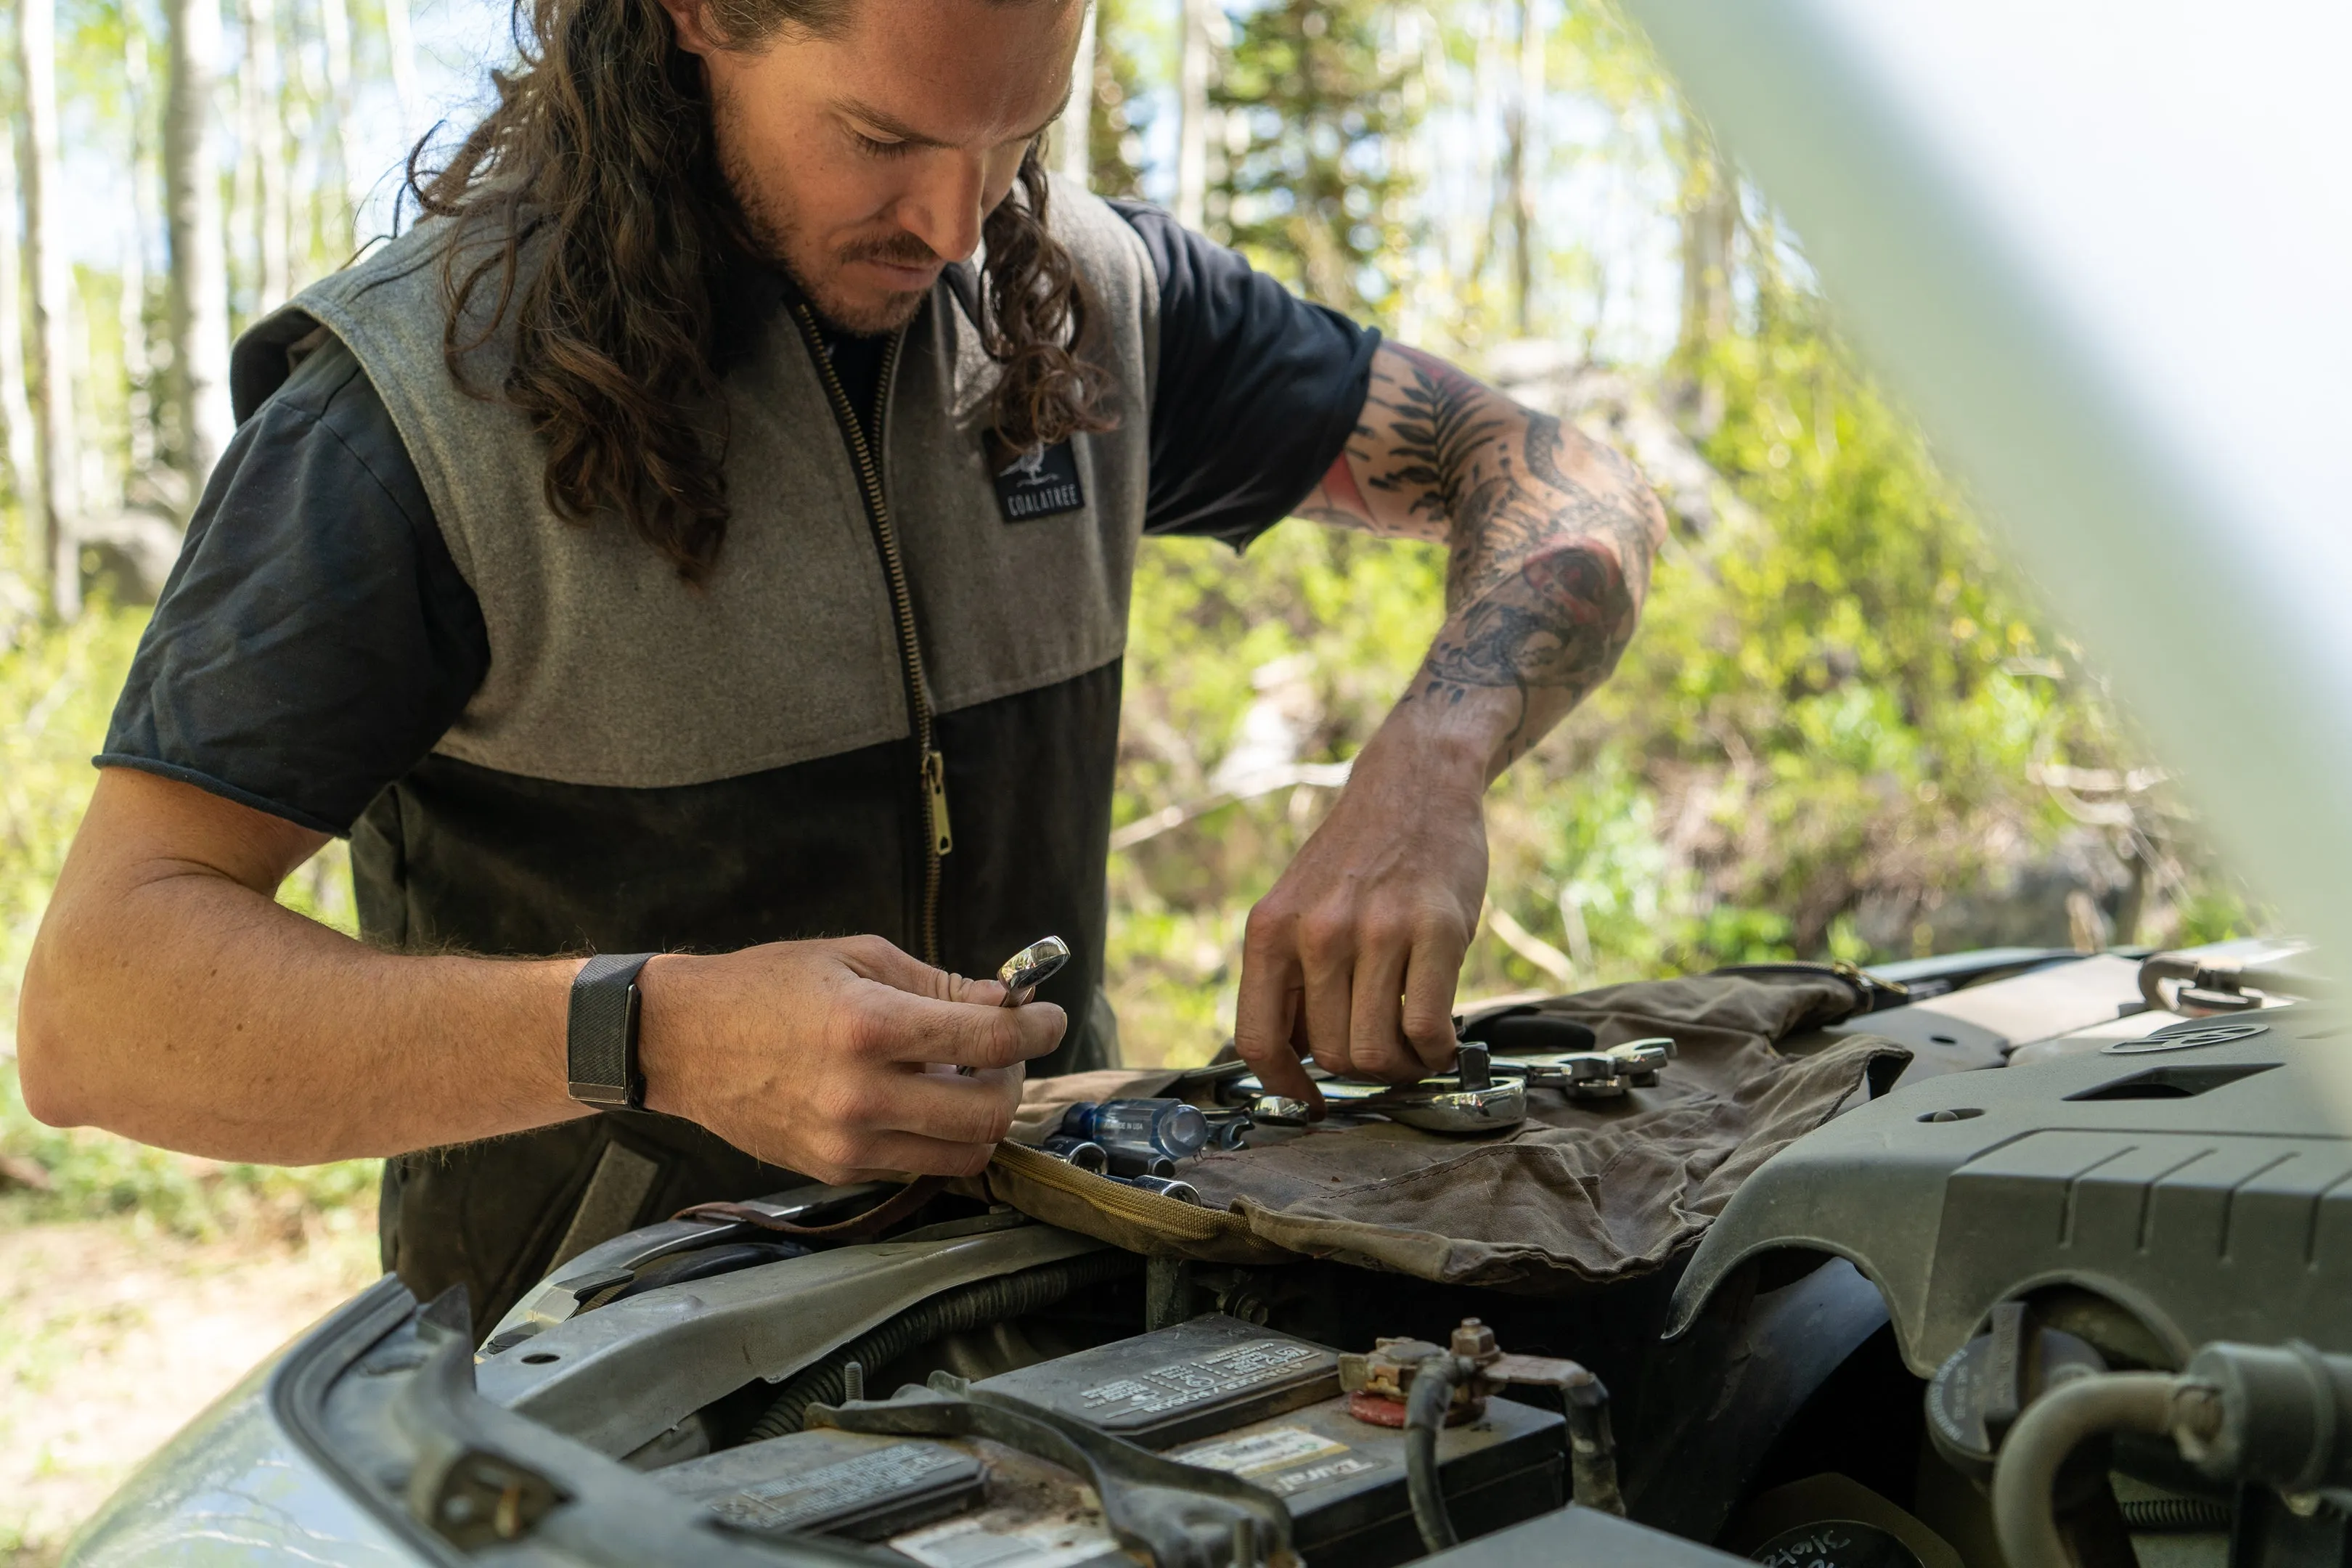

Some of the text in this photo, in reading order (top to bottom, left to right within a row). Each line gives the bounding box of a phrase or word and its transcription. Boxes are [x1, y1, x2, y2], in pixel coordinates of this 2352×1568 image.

[1007, 484, 1077, 516] COALATREE
[1222, 1368, 1293, 1391] DANGER
[1142, 1390, 1212, 1413] POISON
[1271, 1458, 1374, 1491] Dural
